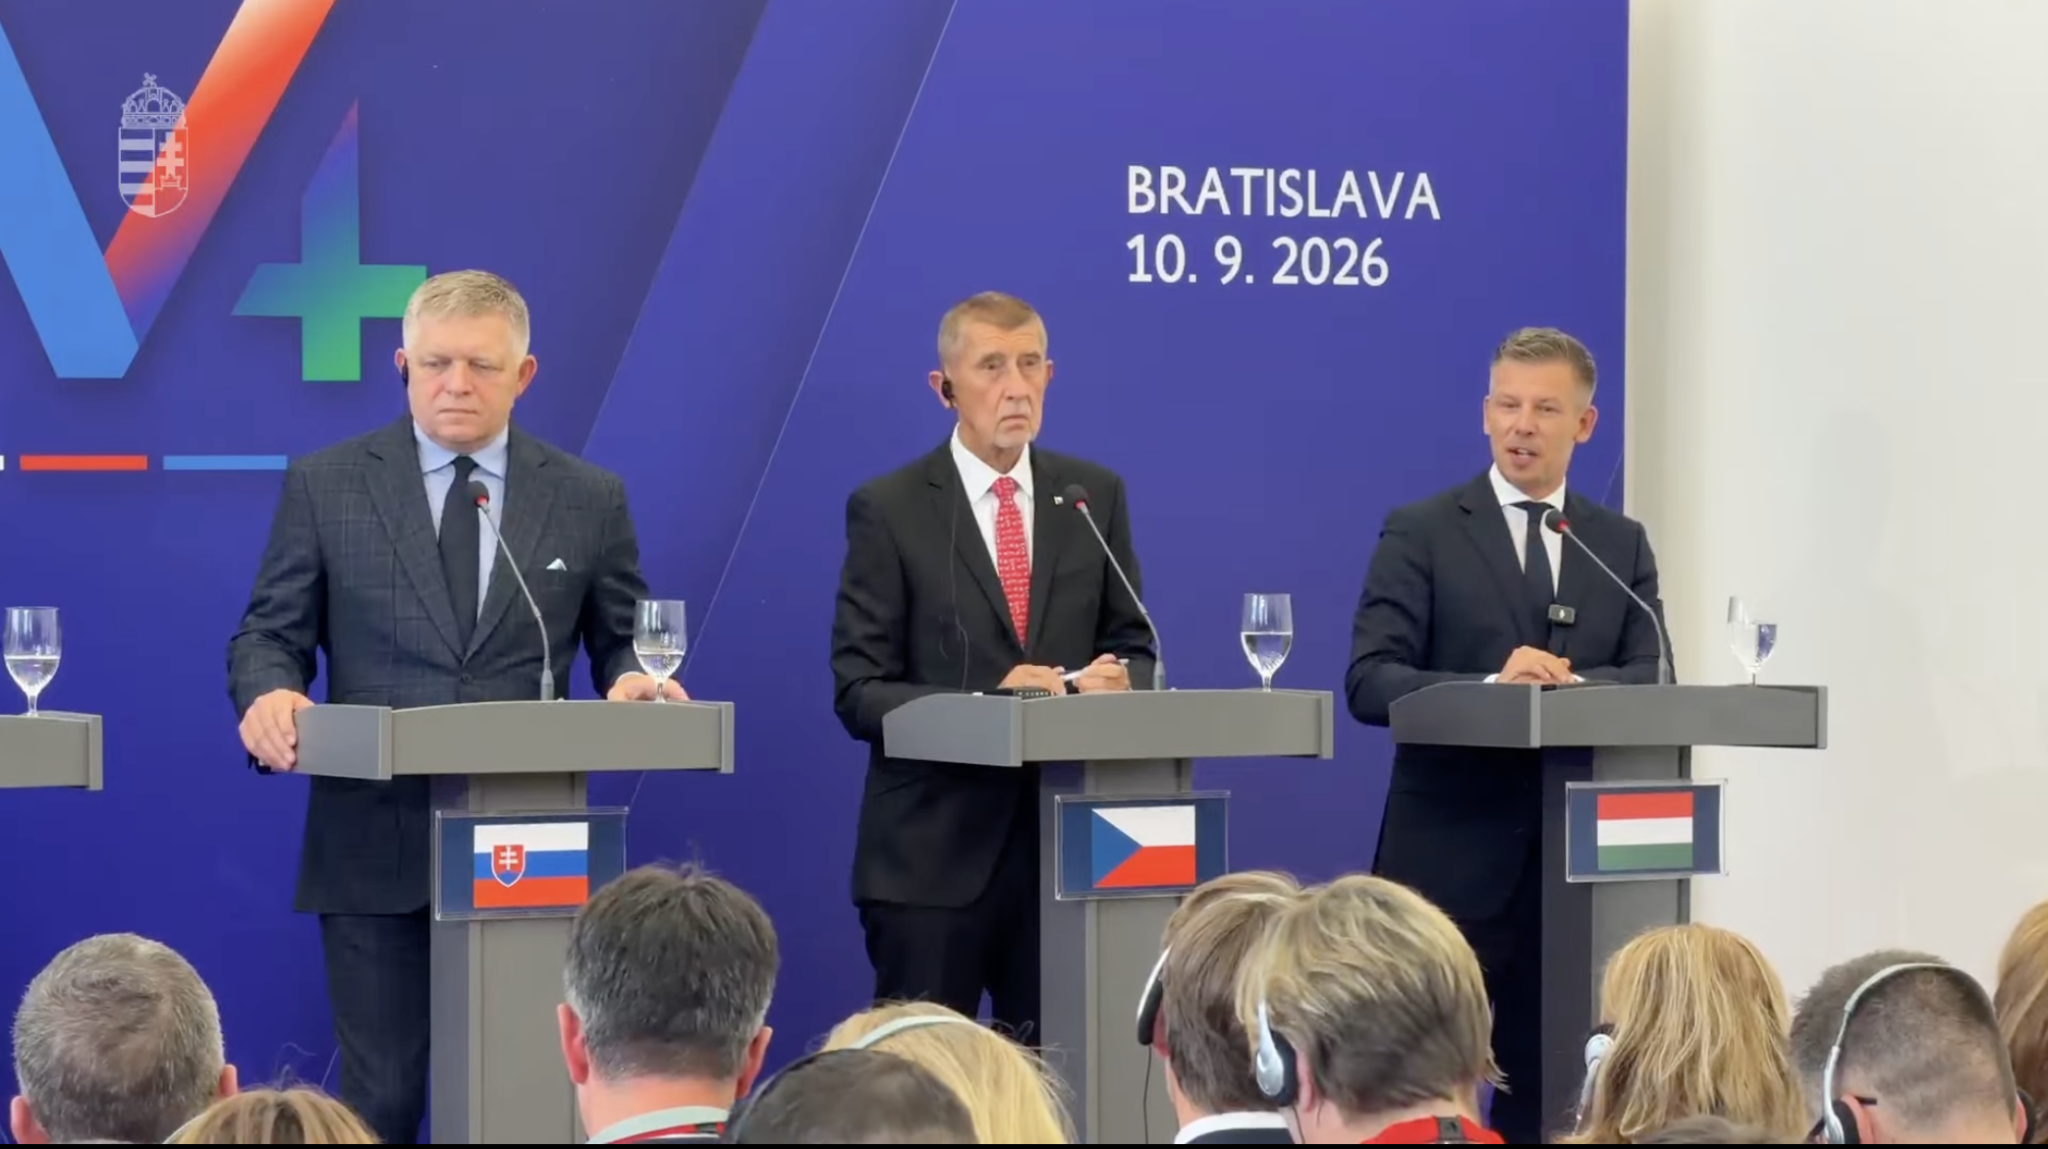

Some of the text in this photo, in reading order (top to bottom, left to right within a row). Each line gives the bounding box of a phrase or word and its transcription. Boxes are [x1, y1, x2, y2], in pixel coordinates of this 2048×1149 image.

[0, 0, 427, 381] V4
[1128, 165, 1441, 220] BRATISLAVA
[1126, 233, 1389, 287] 10. 9. 2026
